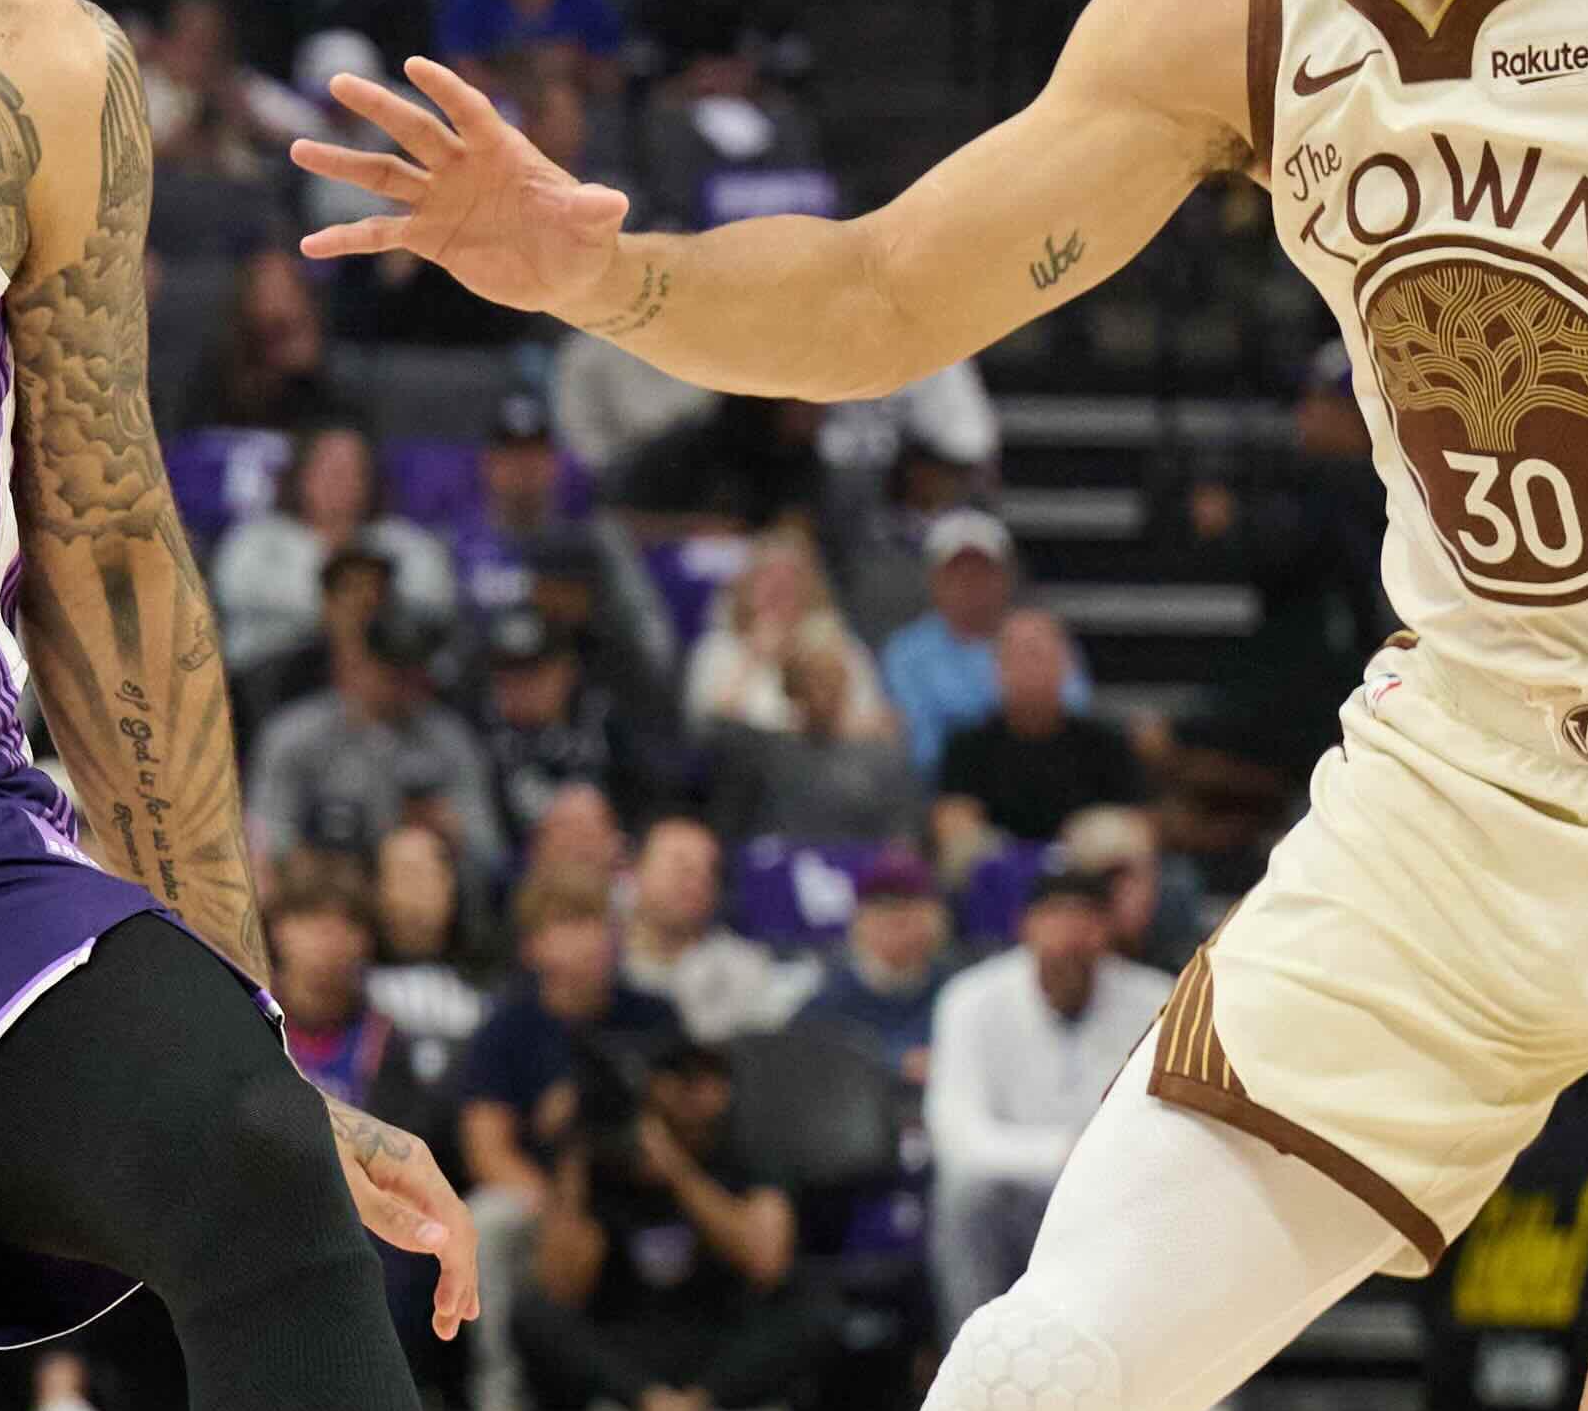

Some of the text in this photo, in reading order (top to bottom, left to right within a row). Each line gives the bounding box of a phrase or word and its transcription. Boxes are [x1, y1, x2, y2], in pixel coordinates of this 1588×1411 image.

[1285, 142, 1342, 201] The
[1441, 450, 1585, 569] 30
[120, 716, 160, 764] God
[139, 769, 156, 786] is
[136, 788, 171, 826] for
[153, 828, 170, 853] us
